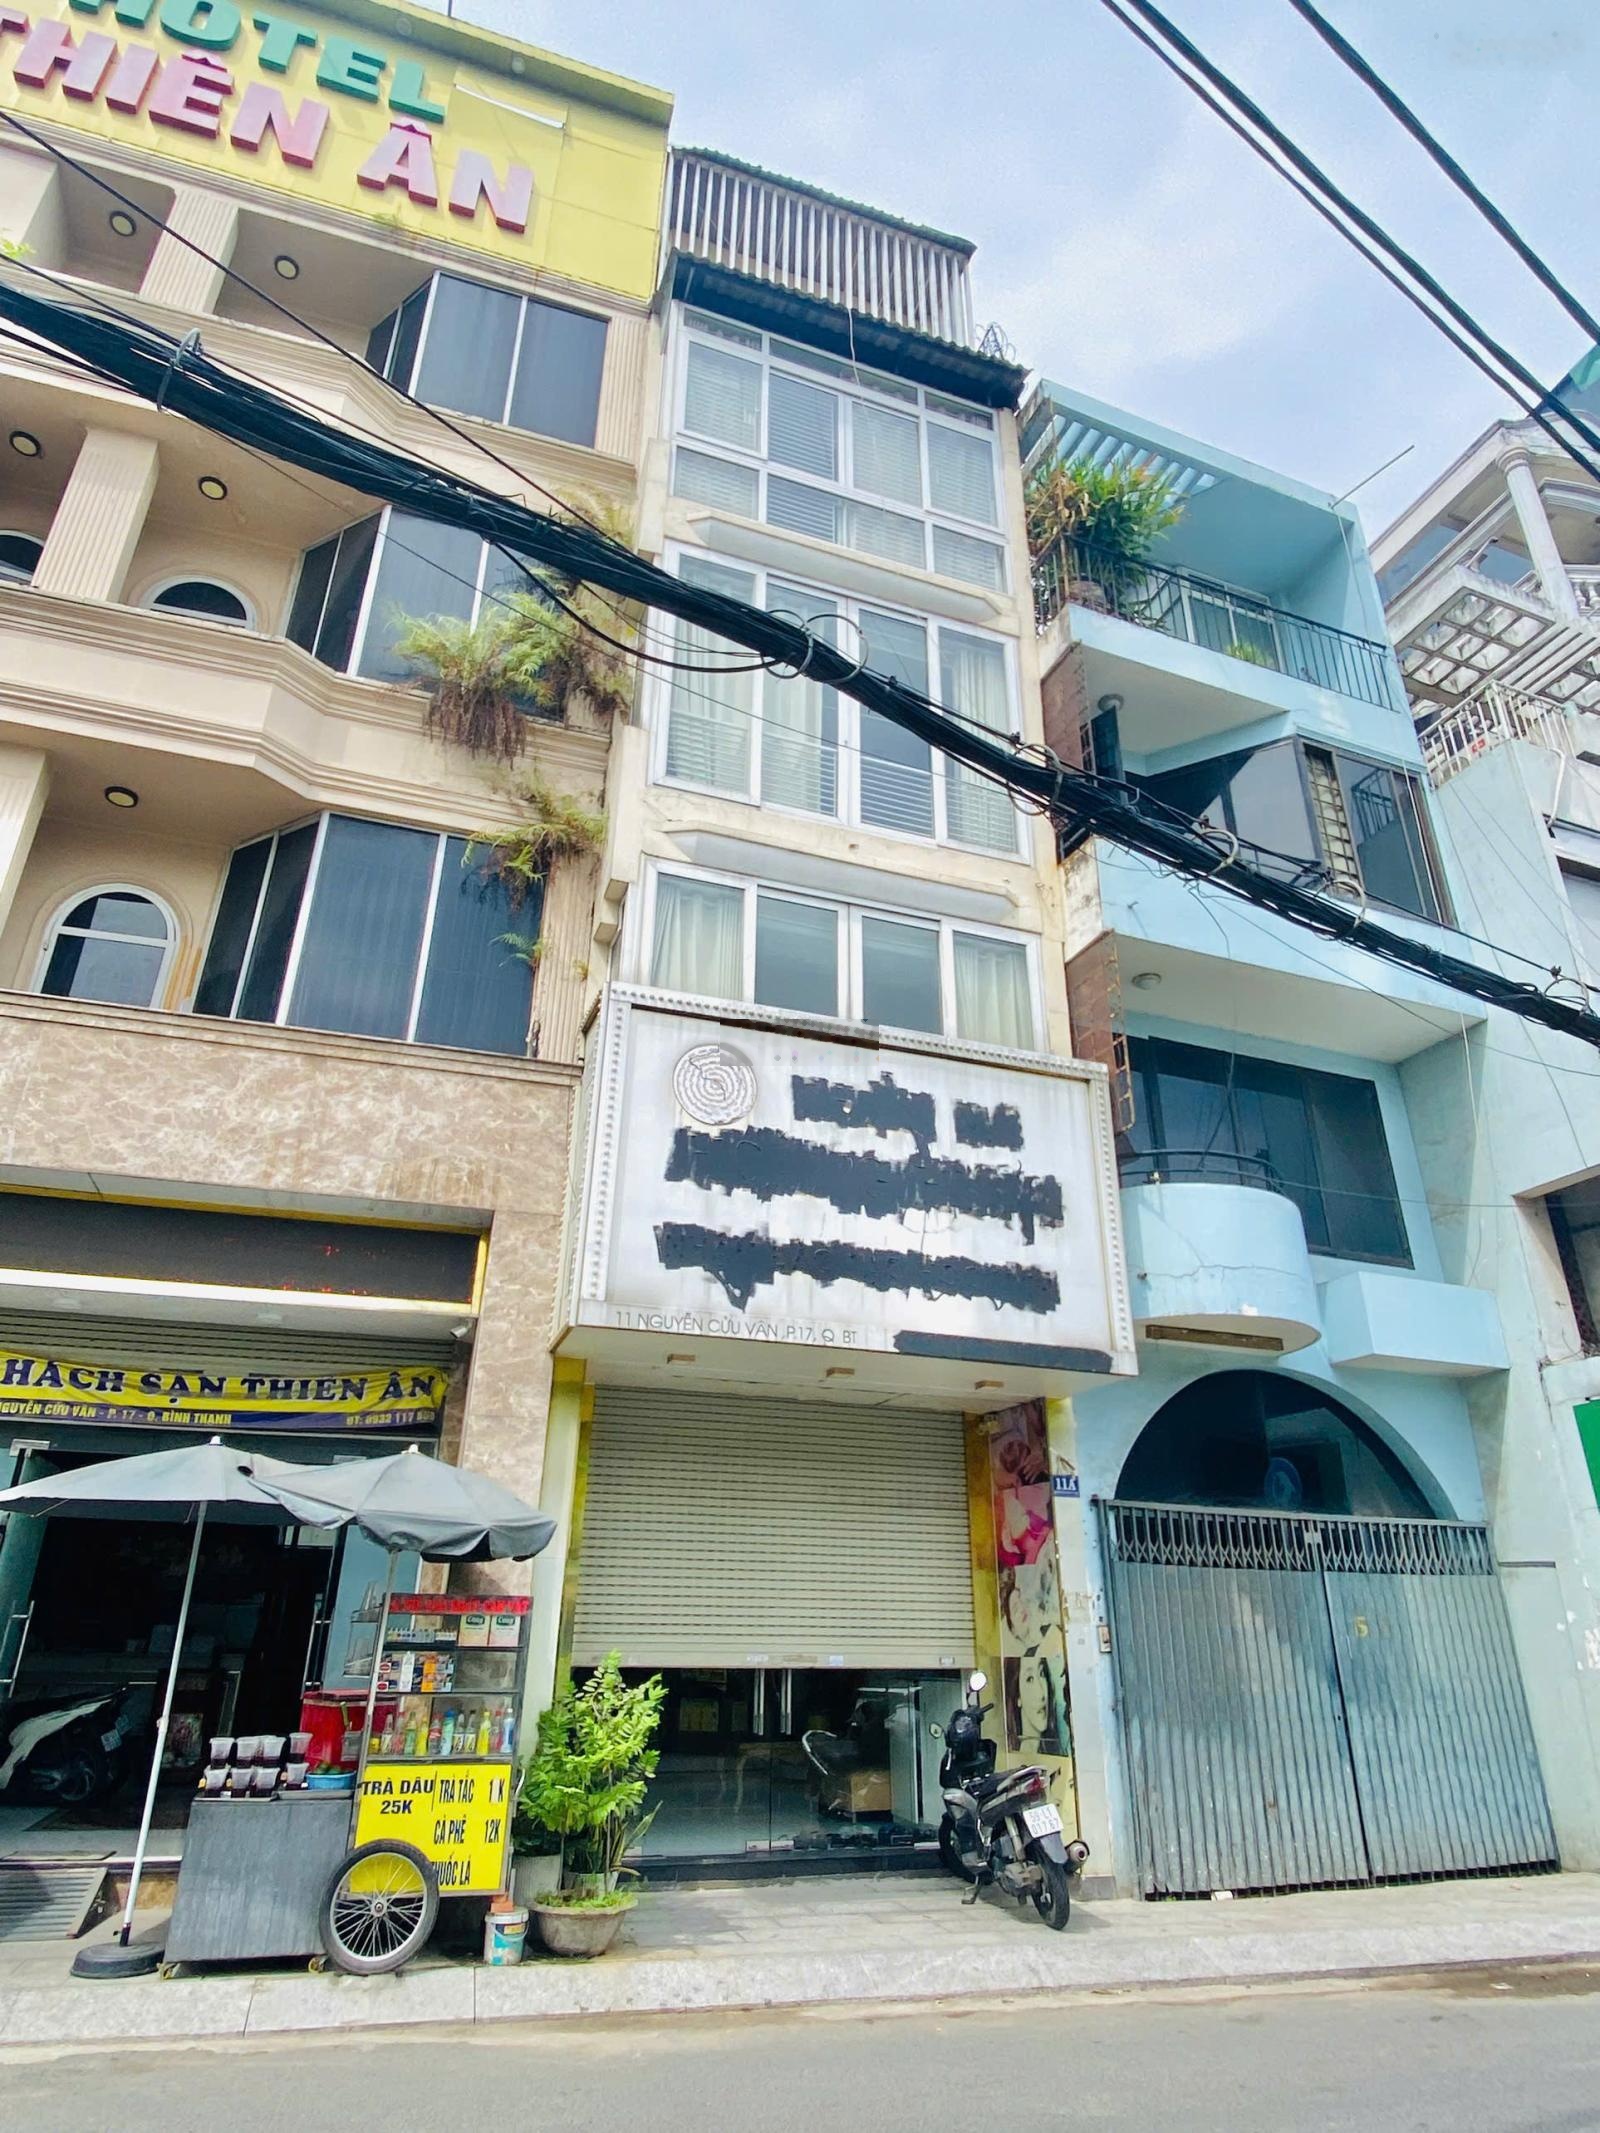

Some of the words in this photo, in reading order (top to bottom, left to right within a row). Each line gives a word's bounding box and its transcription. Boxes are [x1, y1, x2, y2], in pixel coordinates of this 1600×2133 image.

[357, 115, 534, 234] ÂN
[616, 1311, 631, 1327] 11
[637, 1312, 703, 1332] NGUYỄN
[746, 1320, 778, 1338] VÂN
[380, 1371, 435, 1400] ÂN
[362, 1776, 394, 1796] TRÀ
[400, 1777, 434, 1794] DÂU
[439, 1774, 455, 1804] TRÀ
[489, 1778, 506, 1804] 1K
[380, 1800, 413, 1815] 25K
[448, 1814, 467, 1845] PHÊ
[484, 1819, 501, 1844] 12K
[431, 1851, 458, 1887] UỐC
